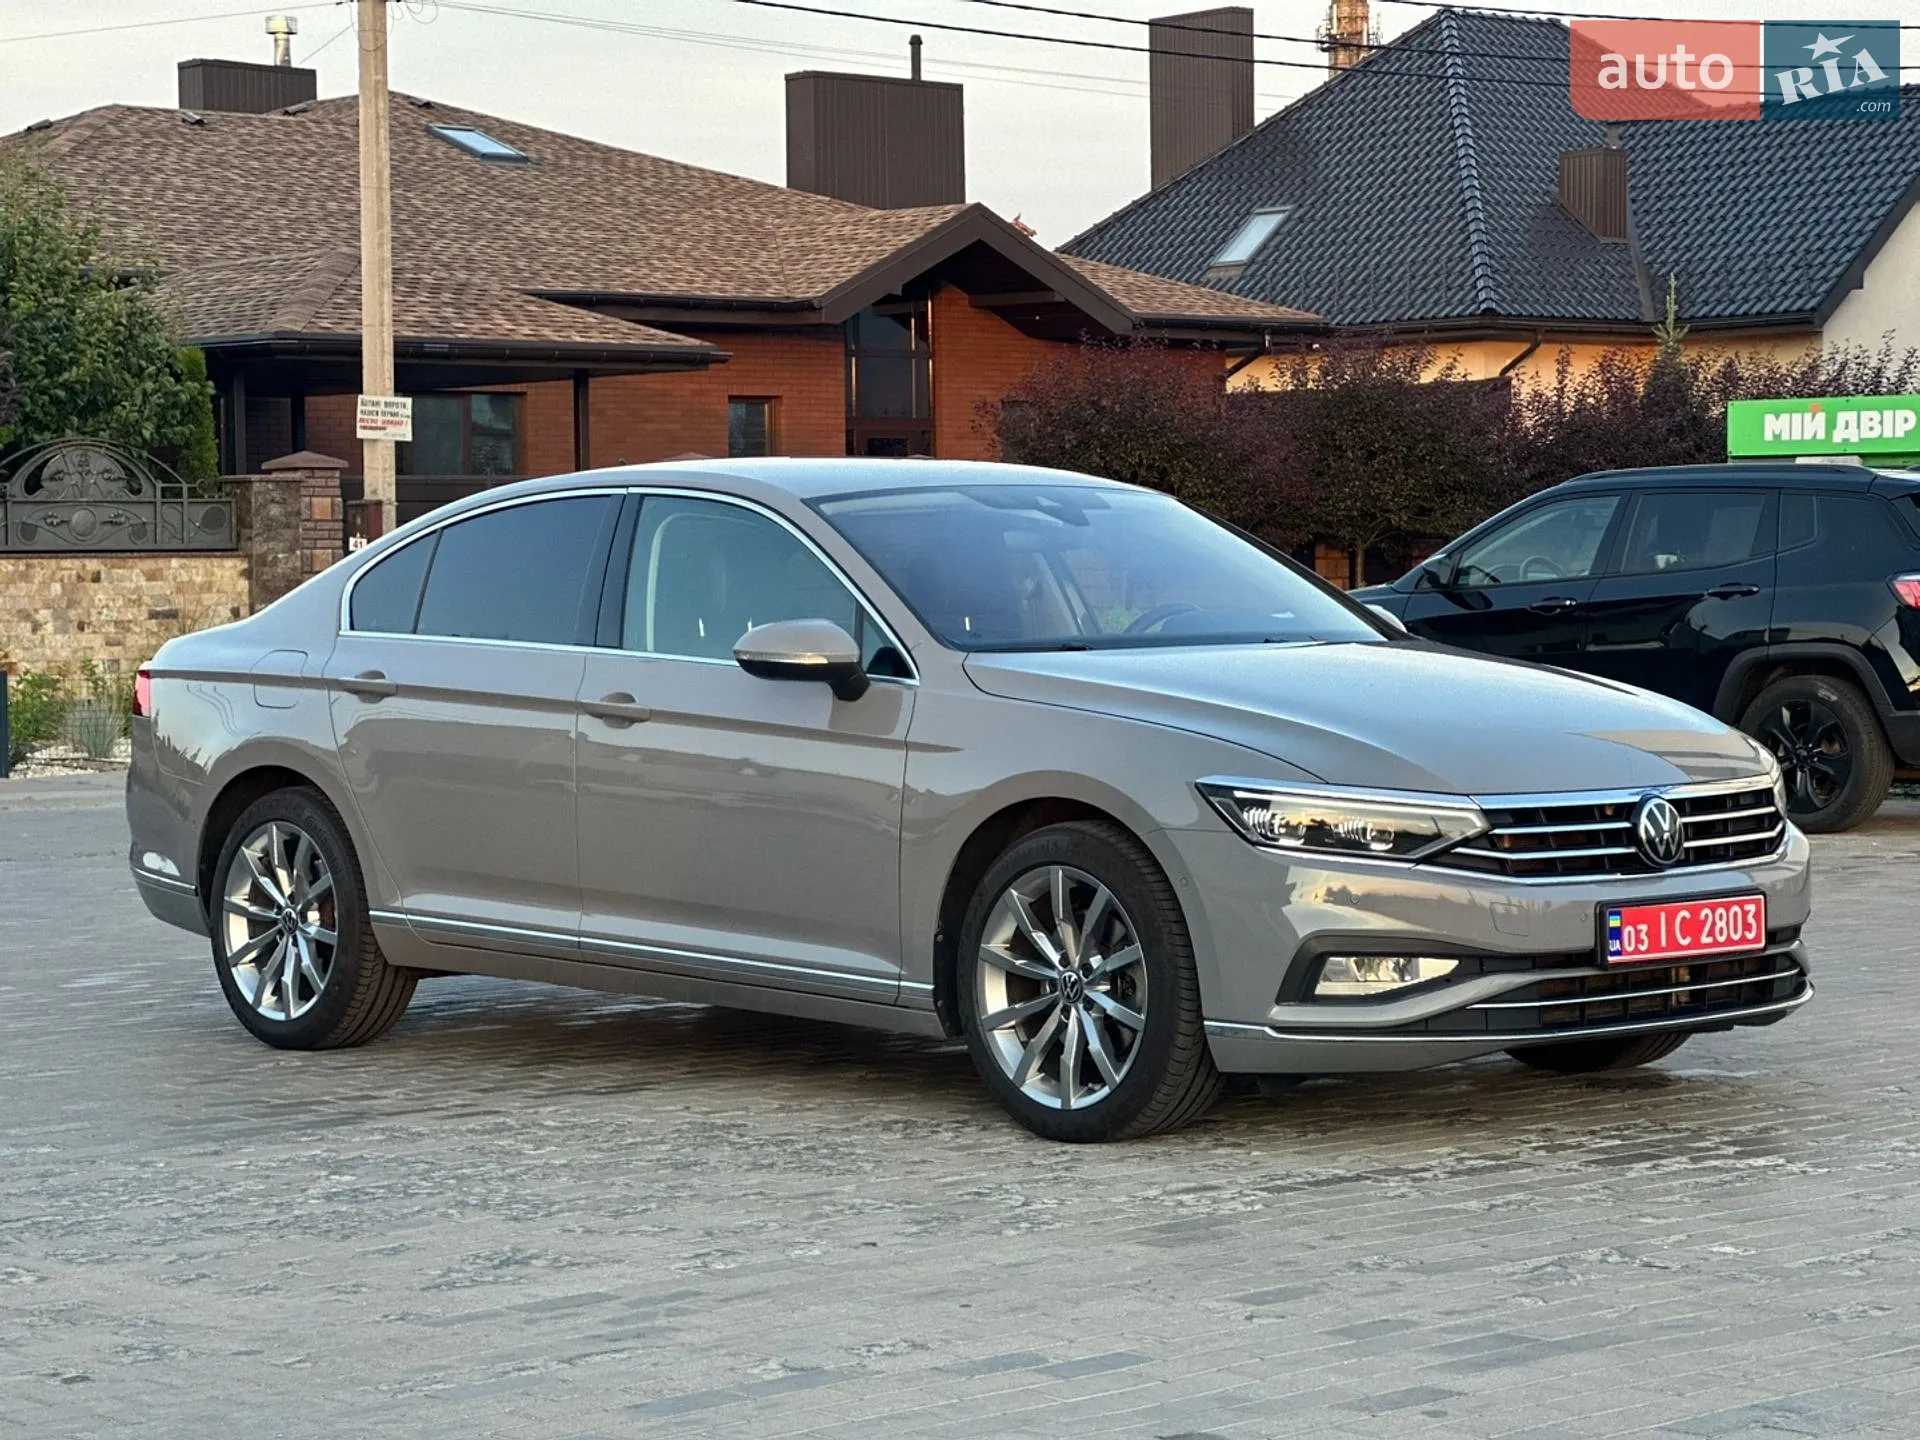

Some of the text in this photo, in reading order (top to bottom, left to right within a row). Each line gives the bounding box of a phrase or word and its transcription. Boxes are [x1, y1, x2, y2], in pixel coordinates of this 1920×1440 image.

[1763, 403, 1917, 443] МІЙ ДВІР
[352, 539, 363, 549] 41
[1623, 903, 1758, 952] 03 IC 2803
[1609, 939, 1622, 952] UA
